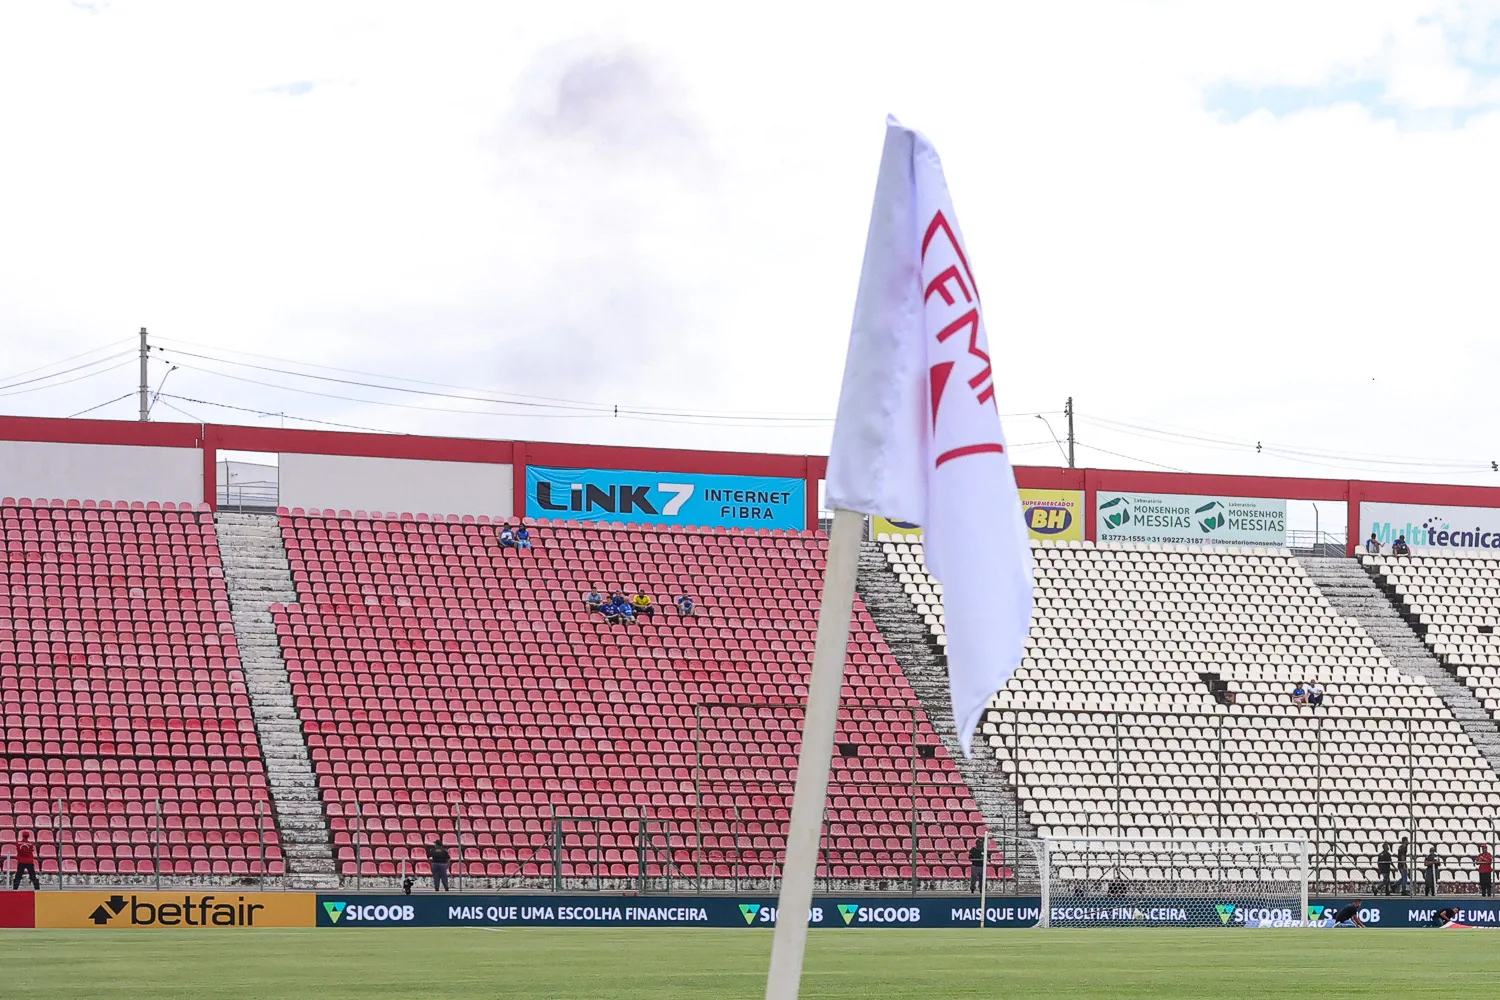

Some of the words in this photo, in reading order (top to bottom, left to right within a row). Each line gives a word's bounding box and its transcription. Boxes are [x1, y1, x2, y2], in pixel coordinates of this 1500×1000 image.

[924, 264, 996, 406] FM
[704, 488, 790, 505] INTERNET
[720, 506, 774, 520] FIBRA
[1134, 505, 1190, 515] MONSENHOR
[1228, 509, 1284, 519] MONSENHOR
[1031, 508, 1066, 529] BH
[1134, 515, 1191, 528] MESSIAS
[1228, 519, 1284, 532] MESSIAS
[1108, 534, 1146, 542] 3773-1555
[1162, 536, 1203, 544] 99227-3187
[130, 895, 265, 926] betfair
[346, 904, 415, 921] SICOOB
[448, 906, 484, 920] MAIS
[486, 906, 518, 921] QUE
[521, 907, 555, 920] UMA
[558, 907, 623, 920] ESCOLHA
[625, 907, 708, 921] FINANCEIRA
[858, 907, 921, 923] SICOOB
[951, 908, 983, 920] MAIS
[986, 908, 1014, 922] QUE
[1051, 907, 1109, 920] ESCOLHA
[1234, 909, 1292, 921] SICOOB
[1468, 909, 1496, 921] UMA
